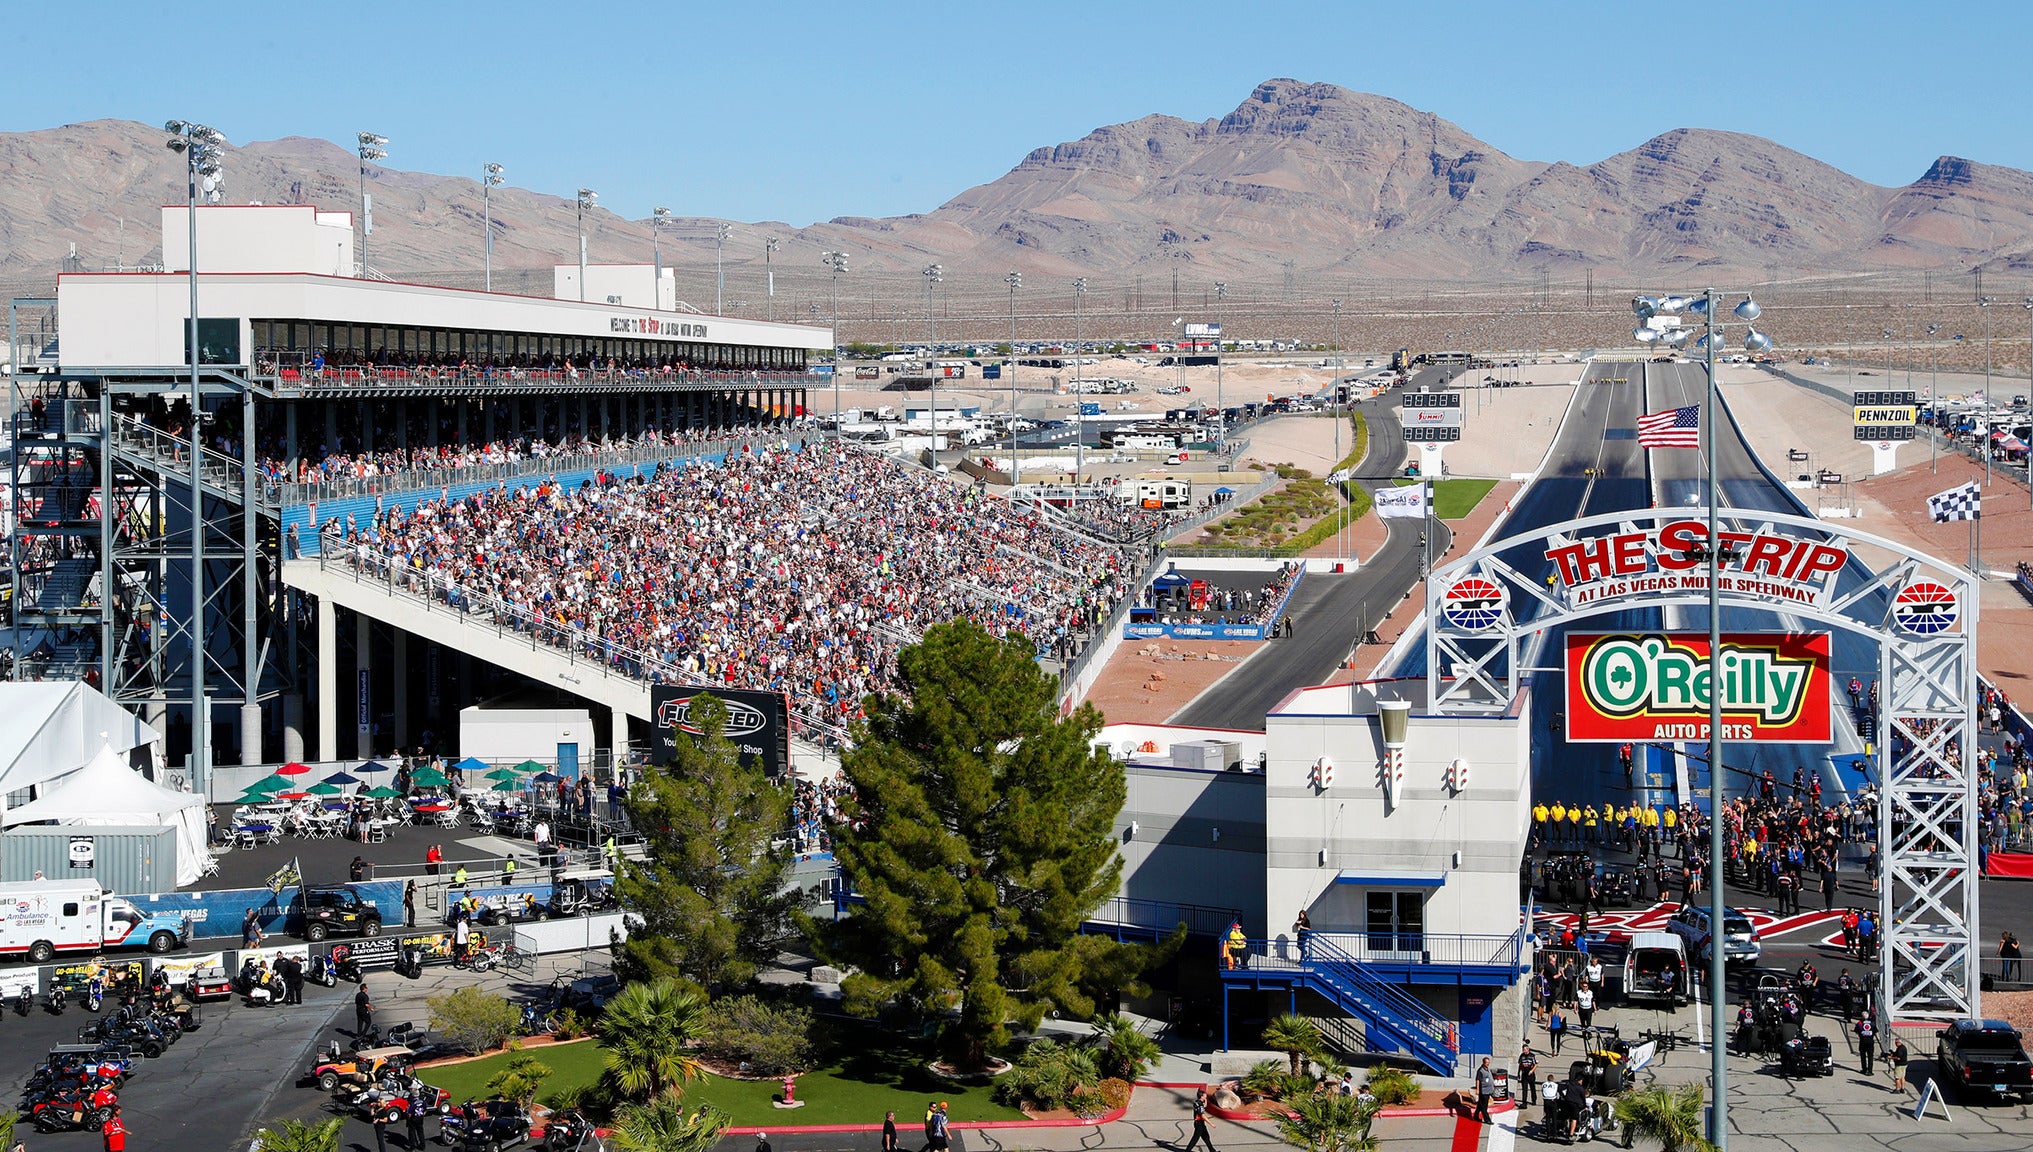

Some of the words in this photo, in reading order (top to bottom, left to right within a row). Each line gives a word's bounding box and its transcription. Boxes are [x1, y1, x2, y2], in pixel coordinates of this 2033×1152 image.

[1858, 409, 1912, 422] PENNZOIL
[1546, 533, 1648, 587] THE
[1657, 521, 1847, 582] STRIP
[1578, 590, 1594, 603] AT
[1600, 583, 1627, 598] LAS
[1630, 577, 1678, 591] VEGAS
[1736, 580, 1816, 604] SPEEDWAY
[1594, 643, 1798, 715] O'Reilly
[1654, 724, 1696, 739] AUTO
[1700, 724, 1753, 739] PRTS
[743, 744, 763, 755] Shop
[6, 912, 50, 920] Ambulance
[181, 908, 208, 918] VEGAS
[351, 938, 396, 950] TRASK
[352, 945, 395, 955] PERFORMANCE
